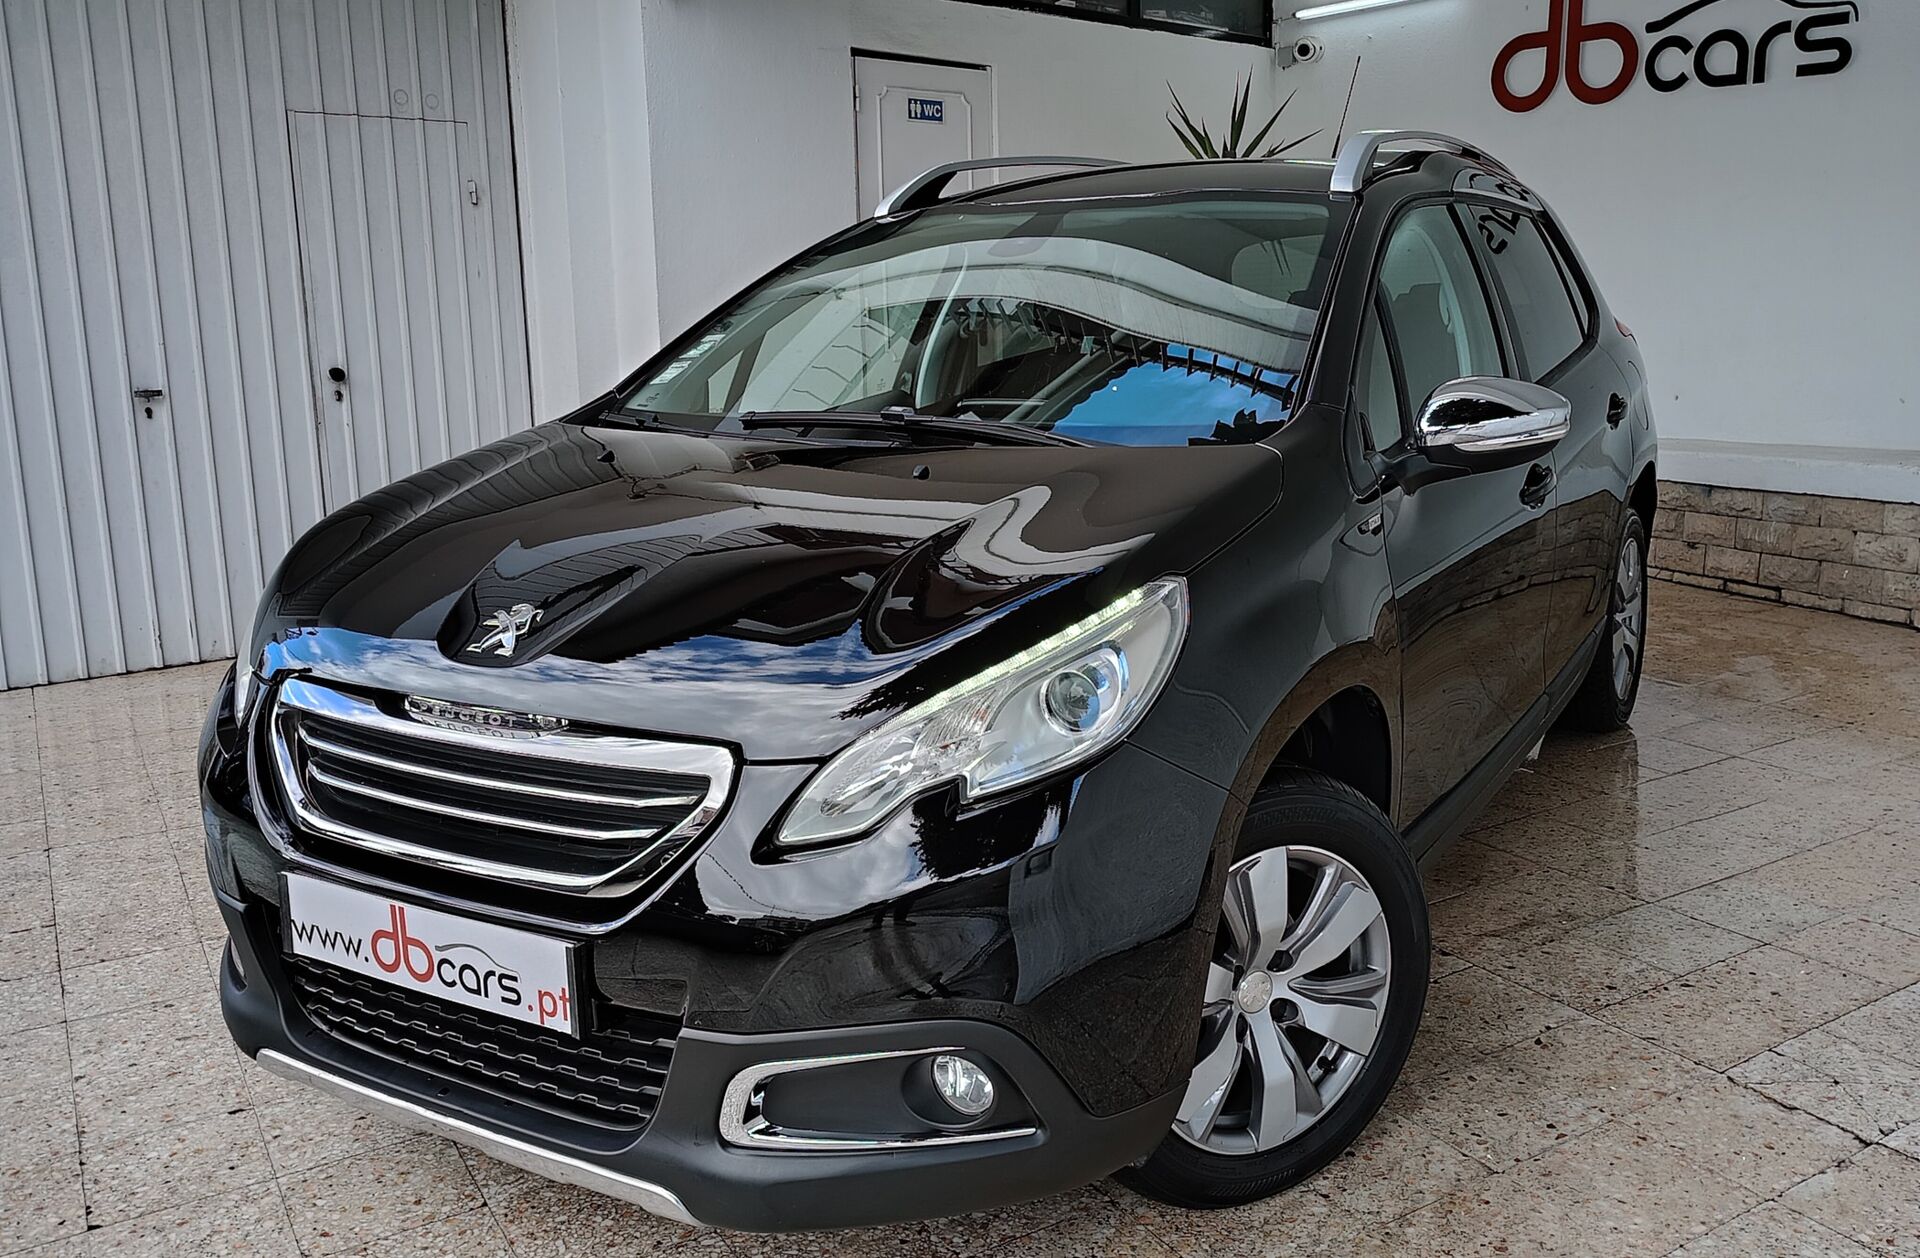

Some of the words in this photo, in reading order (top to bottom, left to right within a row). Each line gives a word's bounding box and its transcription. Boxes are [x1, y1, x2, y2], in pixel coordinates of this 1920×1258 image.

[923, 104, 941, 117] WC
[419, 702, 517, 727] PEUGEOT
[291, 904, 570, 1025] www.dbcars.pt
